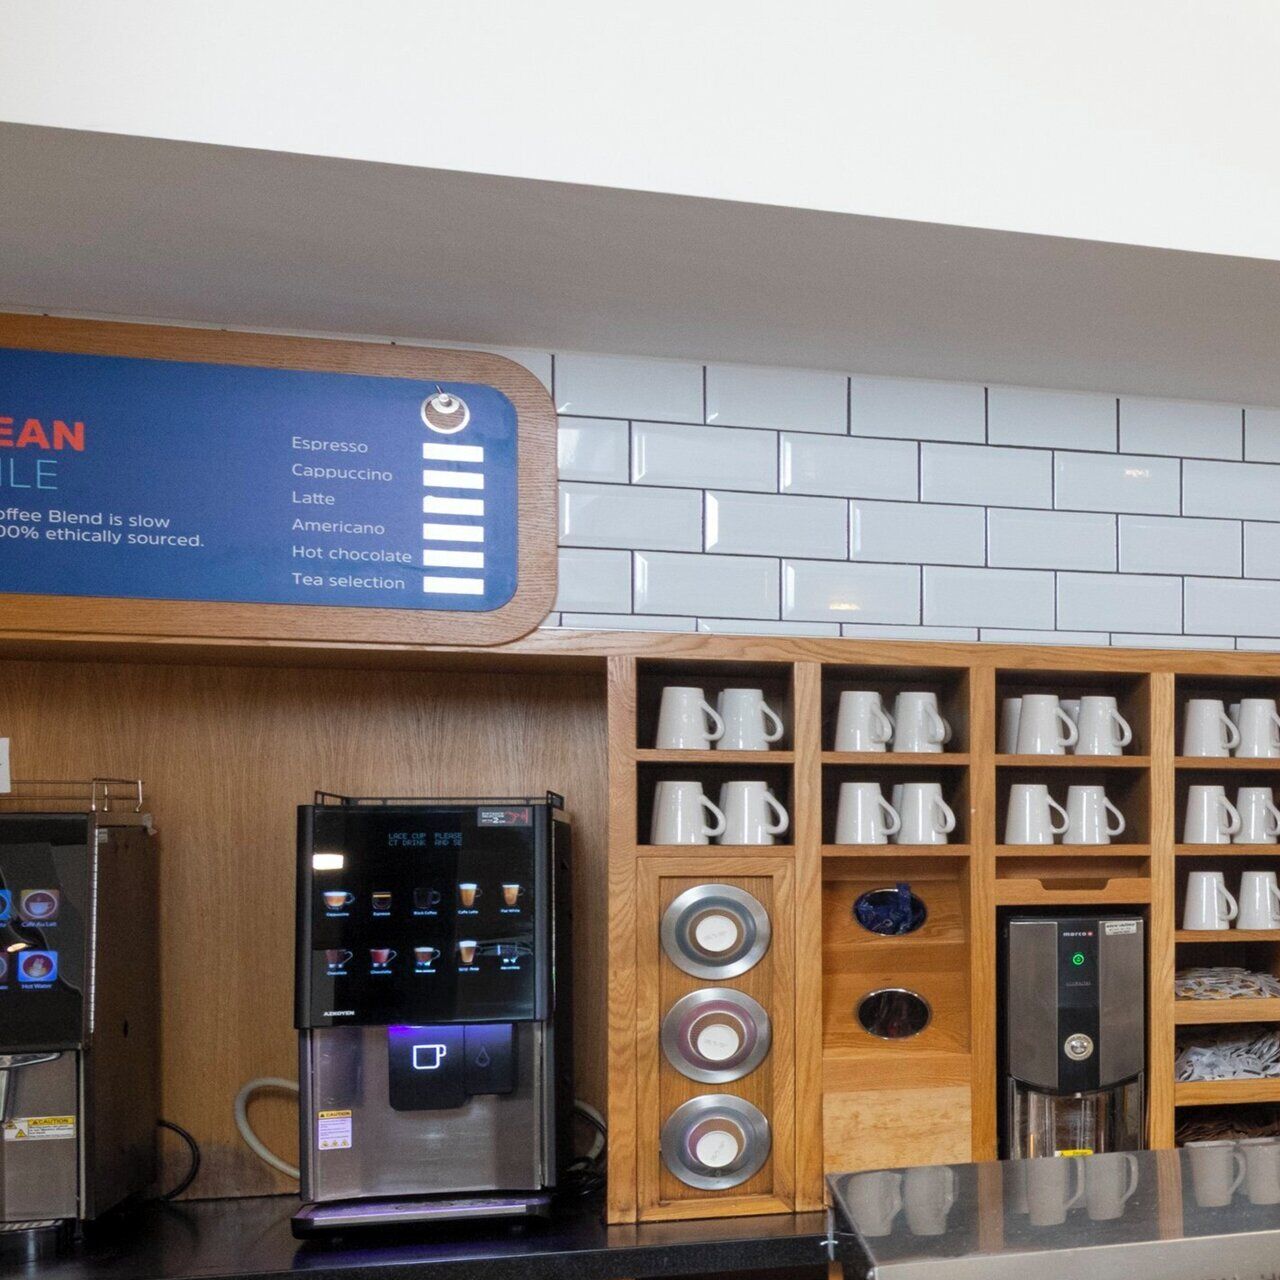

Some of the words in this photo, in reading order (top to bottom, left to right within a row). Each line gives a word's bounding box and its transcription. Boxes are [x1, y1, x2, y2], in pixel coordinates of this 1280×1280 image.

[0, 417, 85, 451] EAN
[292, 436, 368, 453] Espresso
[292, 463, 393, 482] Cappuccino
[292, 491, 335, 505] Latte
[49, 509, 102, 525] Blend
[109, 513, 123, 526] is
[129, 514, 170, 528] slow
[292, 518, 385, 535] Americano
[46, 528, 121, 545] ethically
[128, 533, 204, 547] sourced.
[292, 545, 323, 559] Hot
[329, 547, 412, 563] chocolate
[292, 572, 323, 586] Tea
[329, 574, 405, 590] selection
